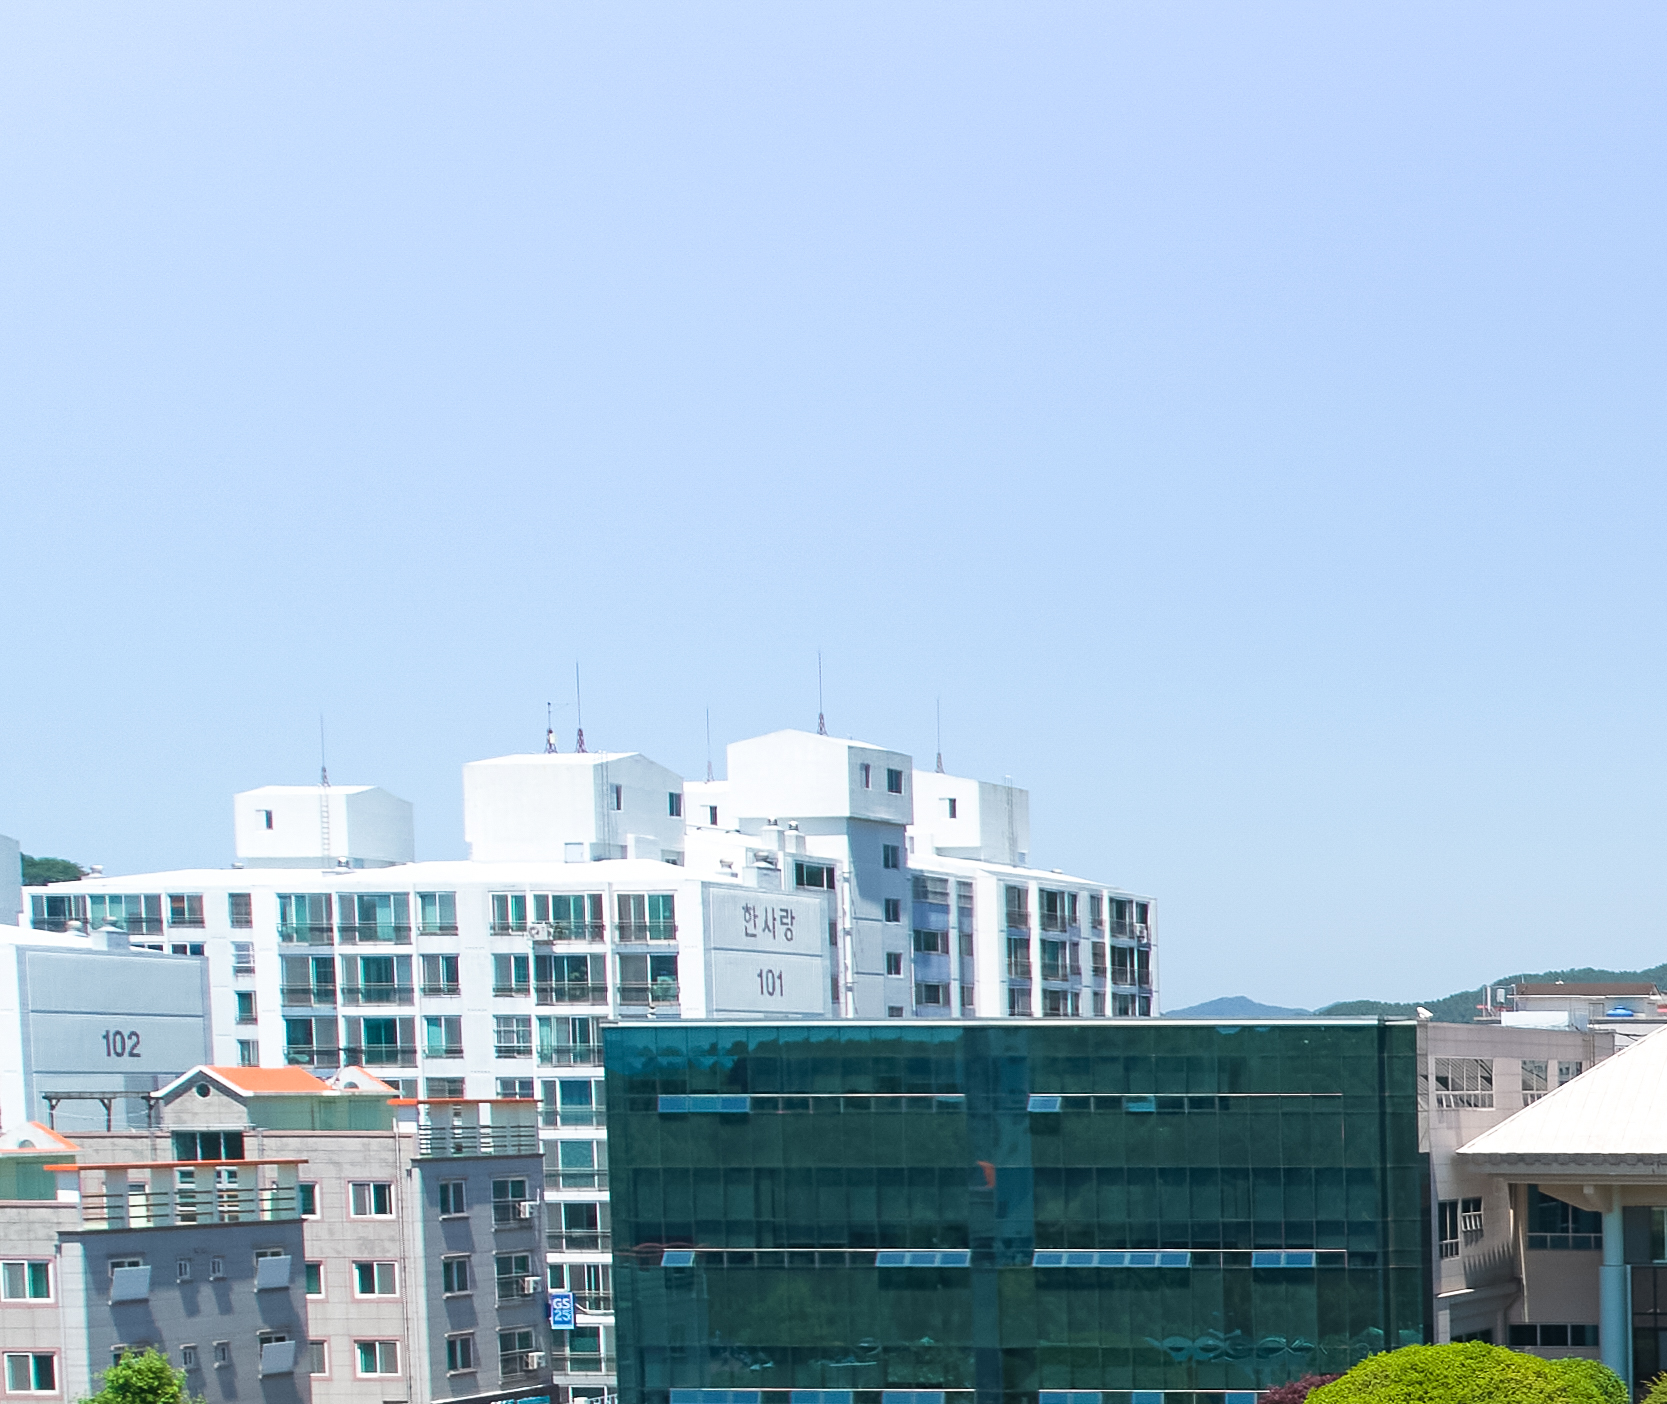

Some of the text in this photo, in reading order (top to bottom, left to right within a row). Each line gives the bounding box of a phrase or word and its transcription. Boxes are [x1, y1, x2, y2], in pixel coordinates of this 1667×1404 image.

[741, 902, 796, 943] 한사랑
[756, 967, 785, 998] 101
[101, 1029, 142, 1059] 102
[552, 1297, 571, 1309] GS
